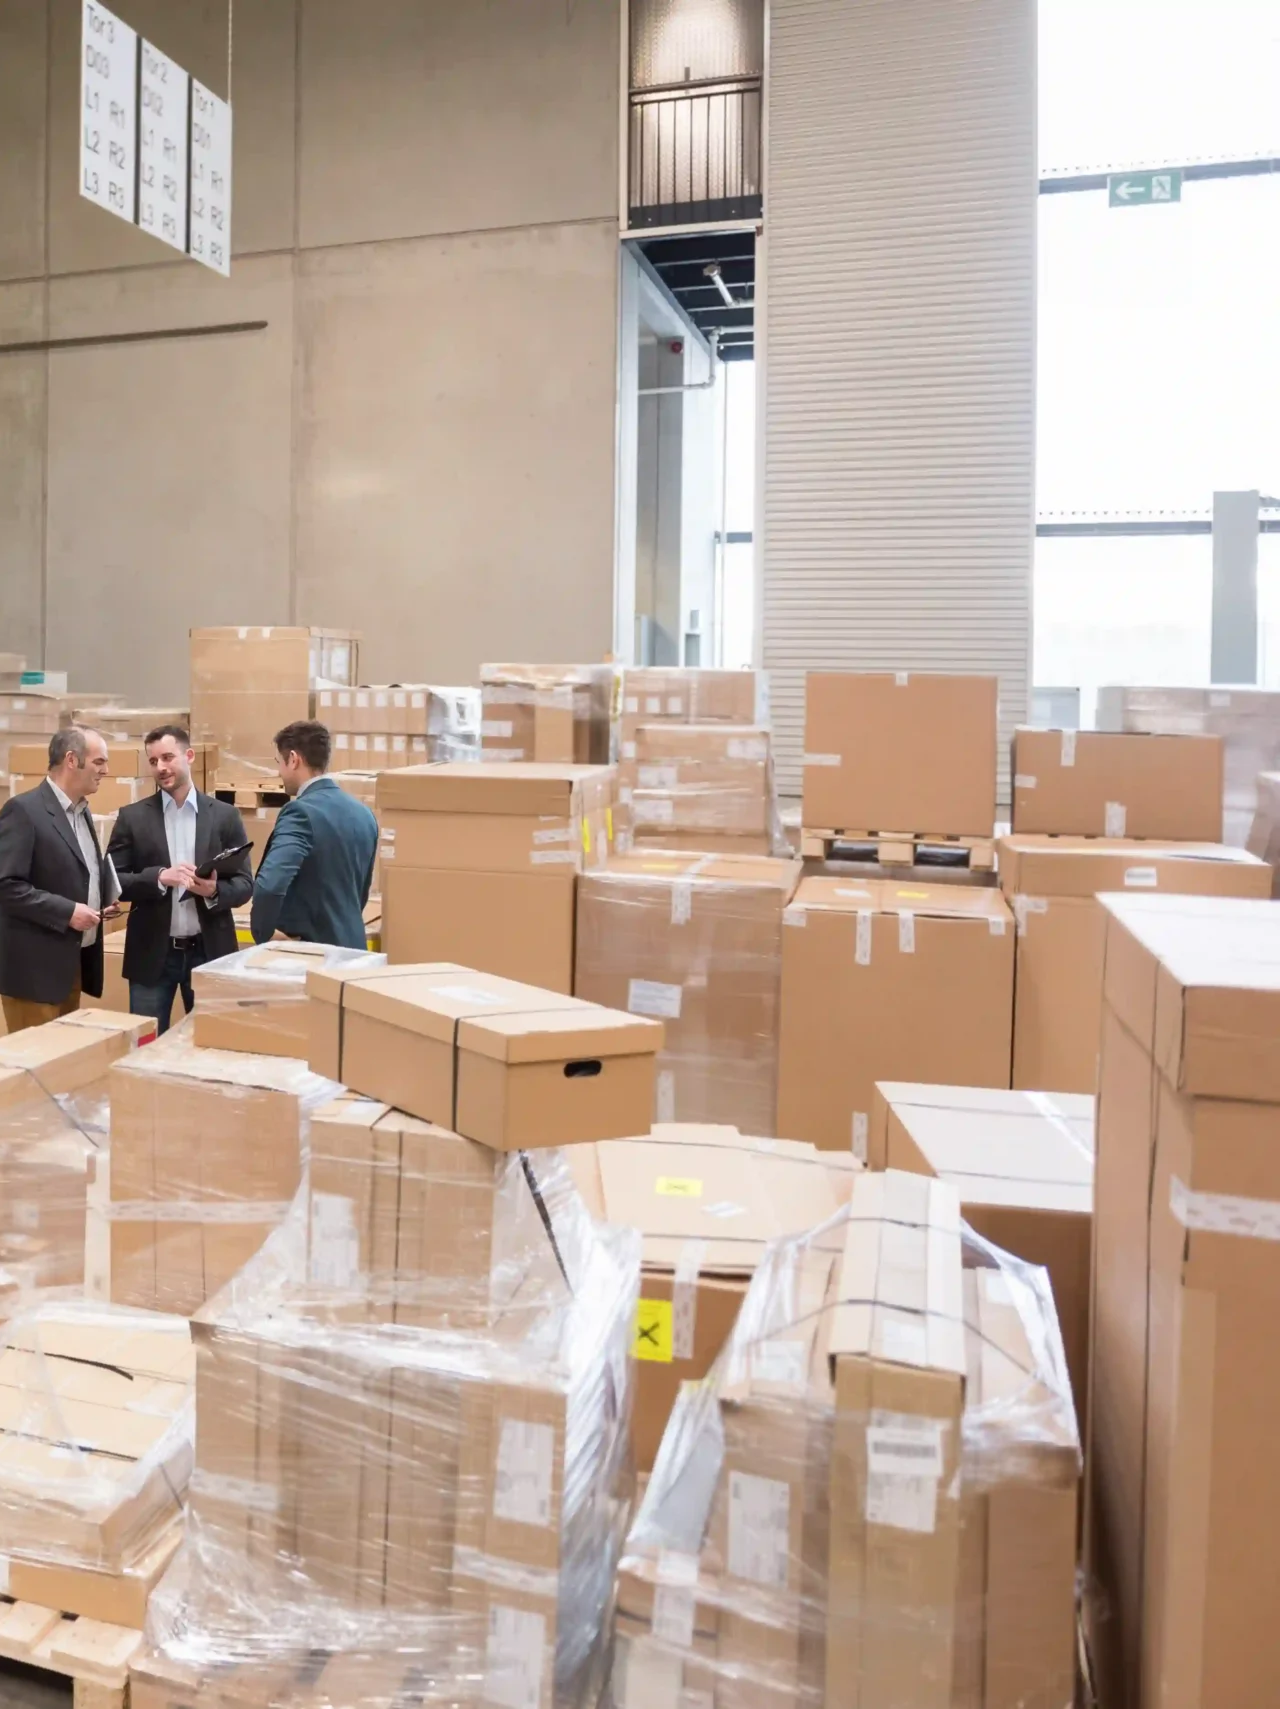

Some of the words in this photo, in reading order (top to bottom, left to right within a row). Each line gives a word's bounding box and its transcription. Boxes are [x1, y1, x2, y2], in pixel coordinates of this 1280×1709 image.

[87, 4, 105, 36] Tor
[85, 84, 99, 113] L1
[110, 101, 125, 129] R1
[85, 127, 100, 154] L2
[109, 141, 125, 169] R2
[142, 125, 153, 150] L1
[163, 138, 176, 164] R1
[84, 168, 99, 194] L3
[109, 181, 124, 209] R3
[142, 162, 154, 188] L2
[163, 175, 177, 203] R2
[211, 170, 223, 195] R1
[141, 200, 154, 226] L3
[162, 213, 175, 239] R3
[193, 194, 204, 219] L2
[211, 206, 223, 231] R2
[192, 231, 203, 255] L3
[211, 242, 223, 266] R3
